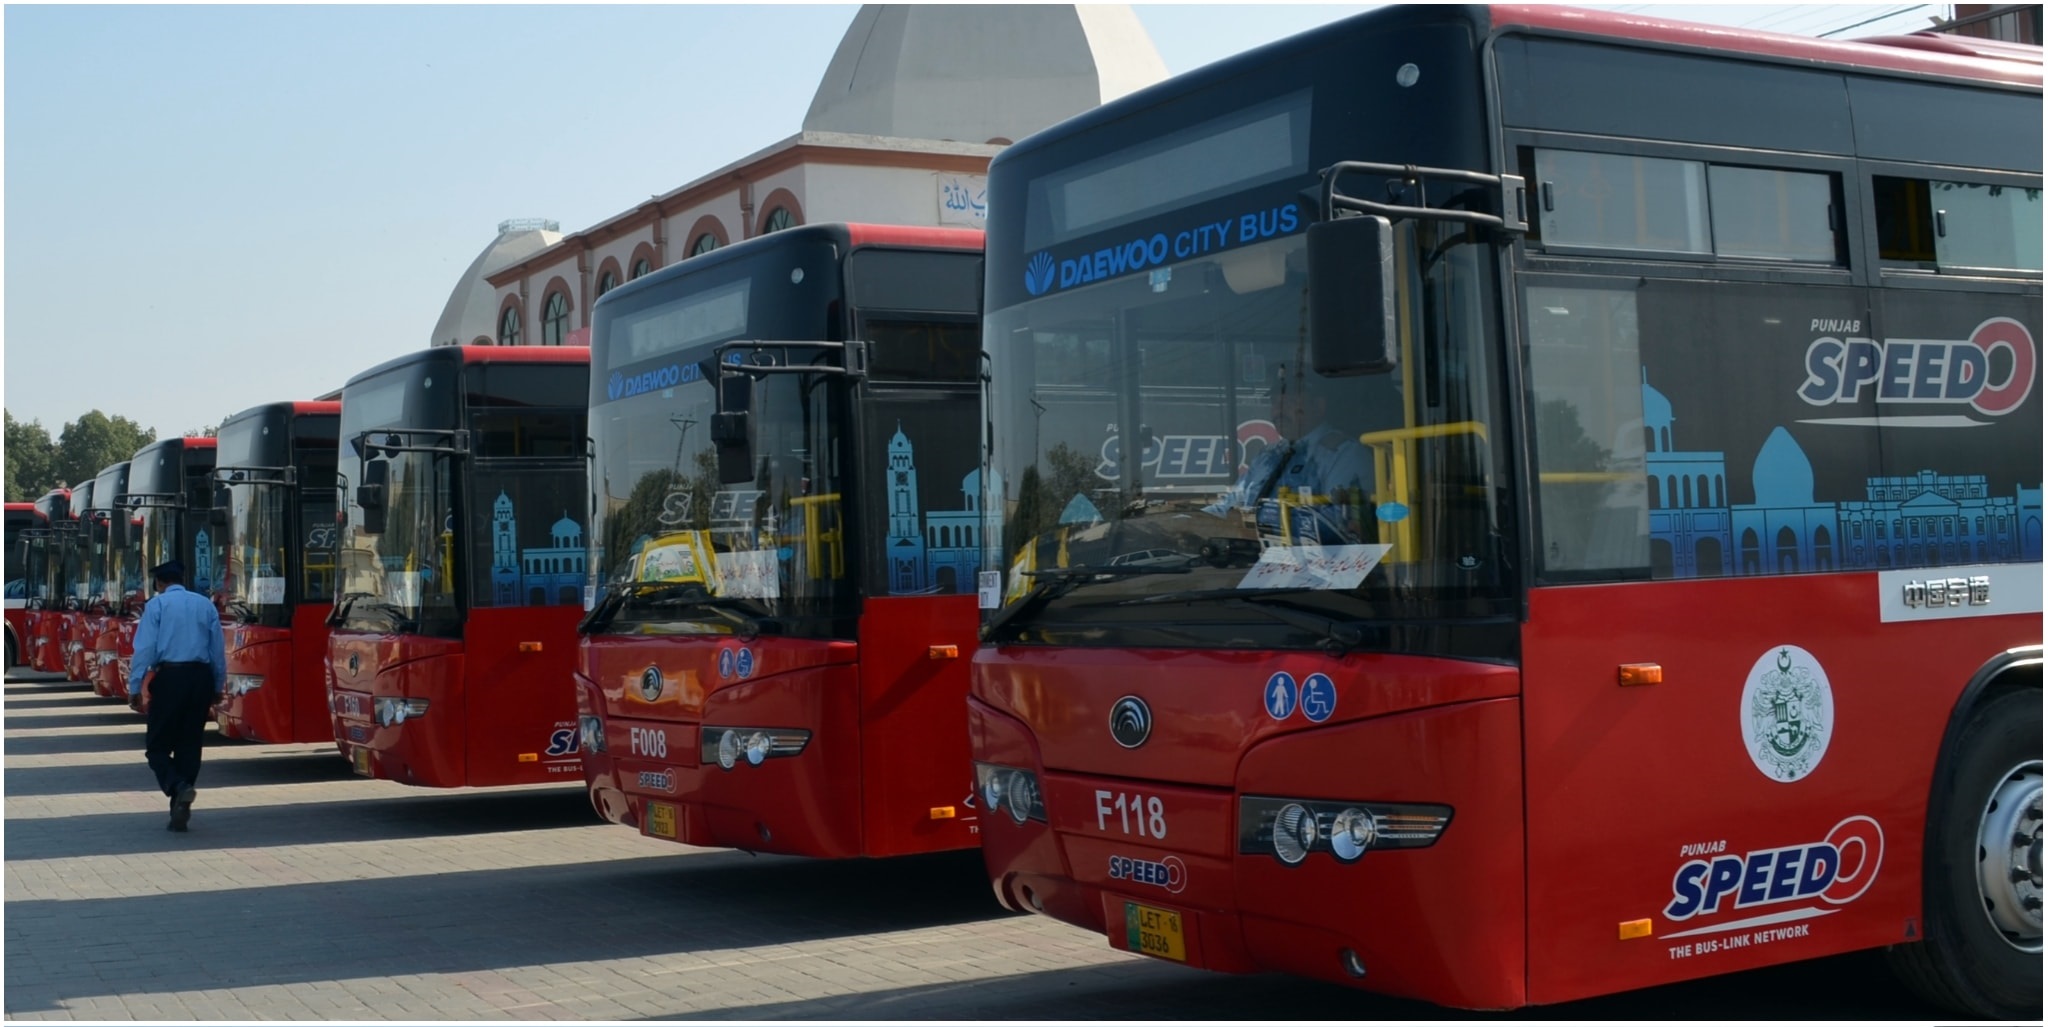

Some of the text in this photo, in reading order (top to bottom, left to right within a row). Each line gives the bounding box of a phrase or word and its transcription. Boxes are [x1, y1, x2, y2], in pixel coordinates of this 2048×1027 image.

[1060, 203, 1298, 289] DAEWOO CITY BUS
[1810, 318, 1861, 333] PUNJAB
[625, 362, 700, 396] DAEWOO CIT
[631, 727, 667, 758] F008
[1095, 790, 1167, 840] F118
[1680, 840, 1726, 858] PUNJAB
[1140, 931, 1169, 953] 3036
[1668, 923, 1809, 960] THE BUS-LINK NETWORK
